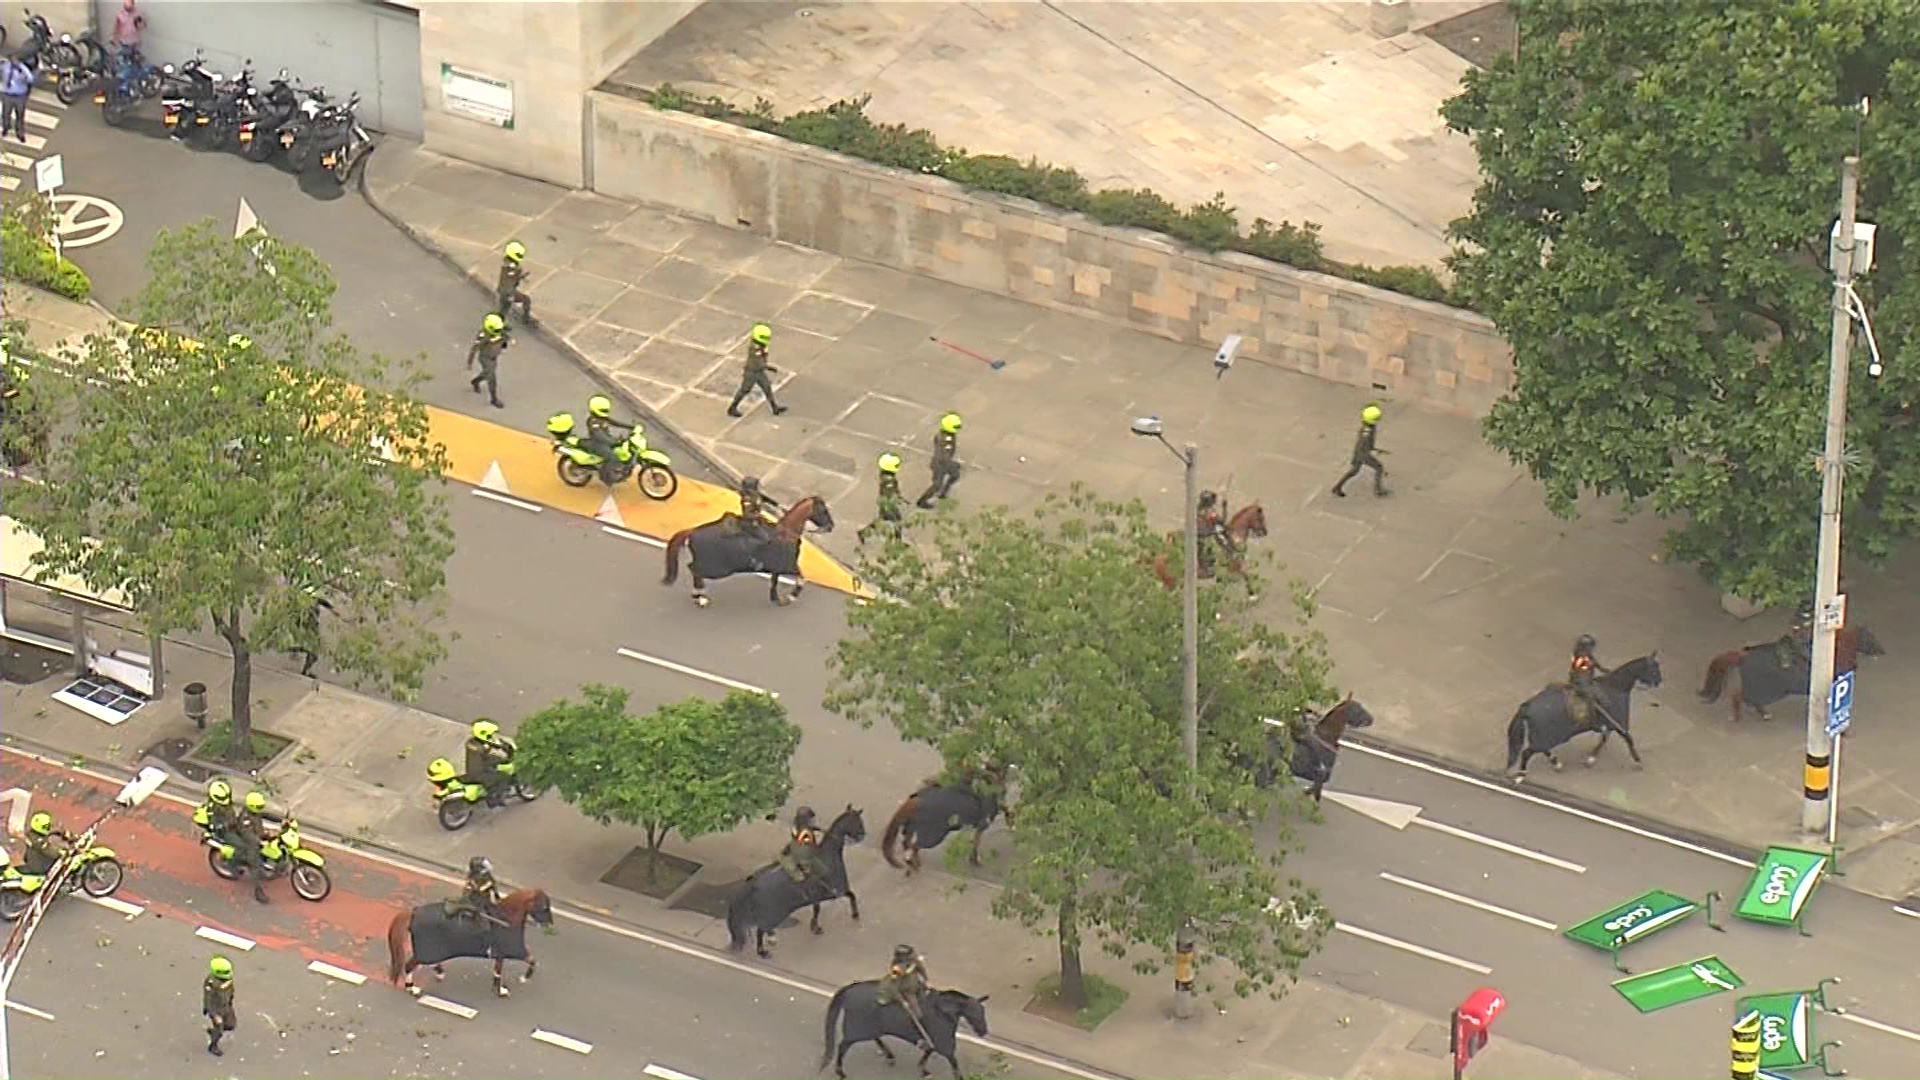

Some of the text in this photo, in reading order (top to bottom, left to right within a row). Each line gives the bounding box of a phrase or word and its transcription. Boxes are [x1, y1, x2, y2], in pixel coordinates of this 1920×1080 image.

[1835, 680, 1848, 709] P
[1760, 866, 1798, 904] epm
[1763, 1016, 1787, 1050] epm
